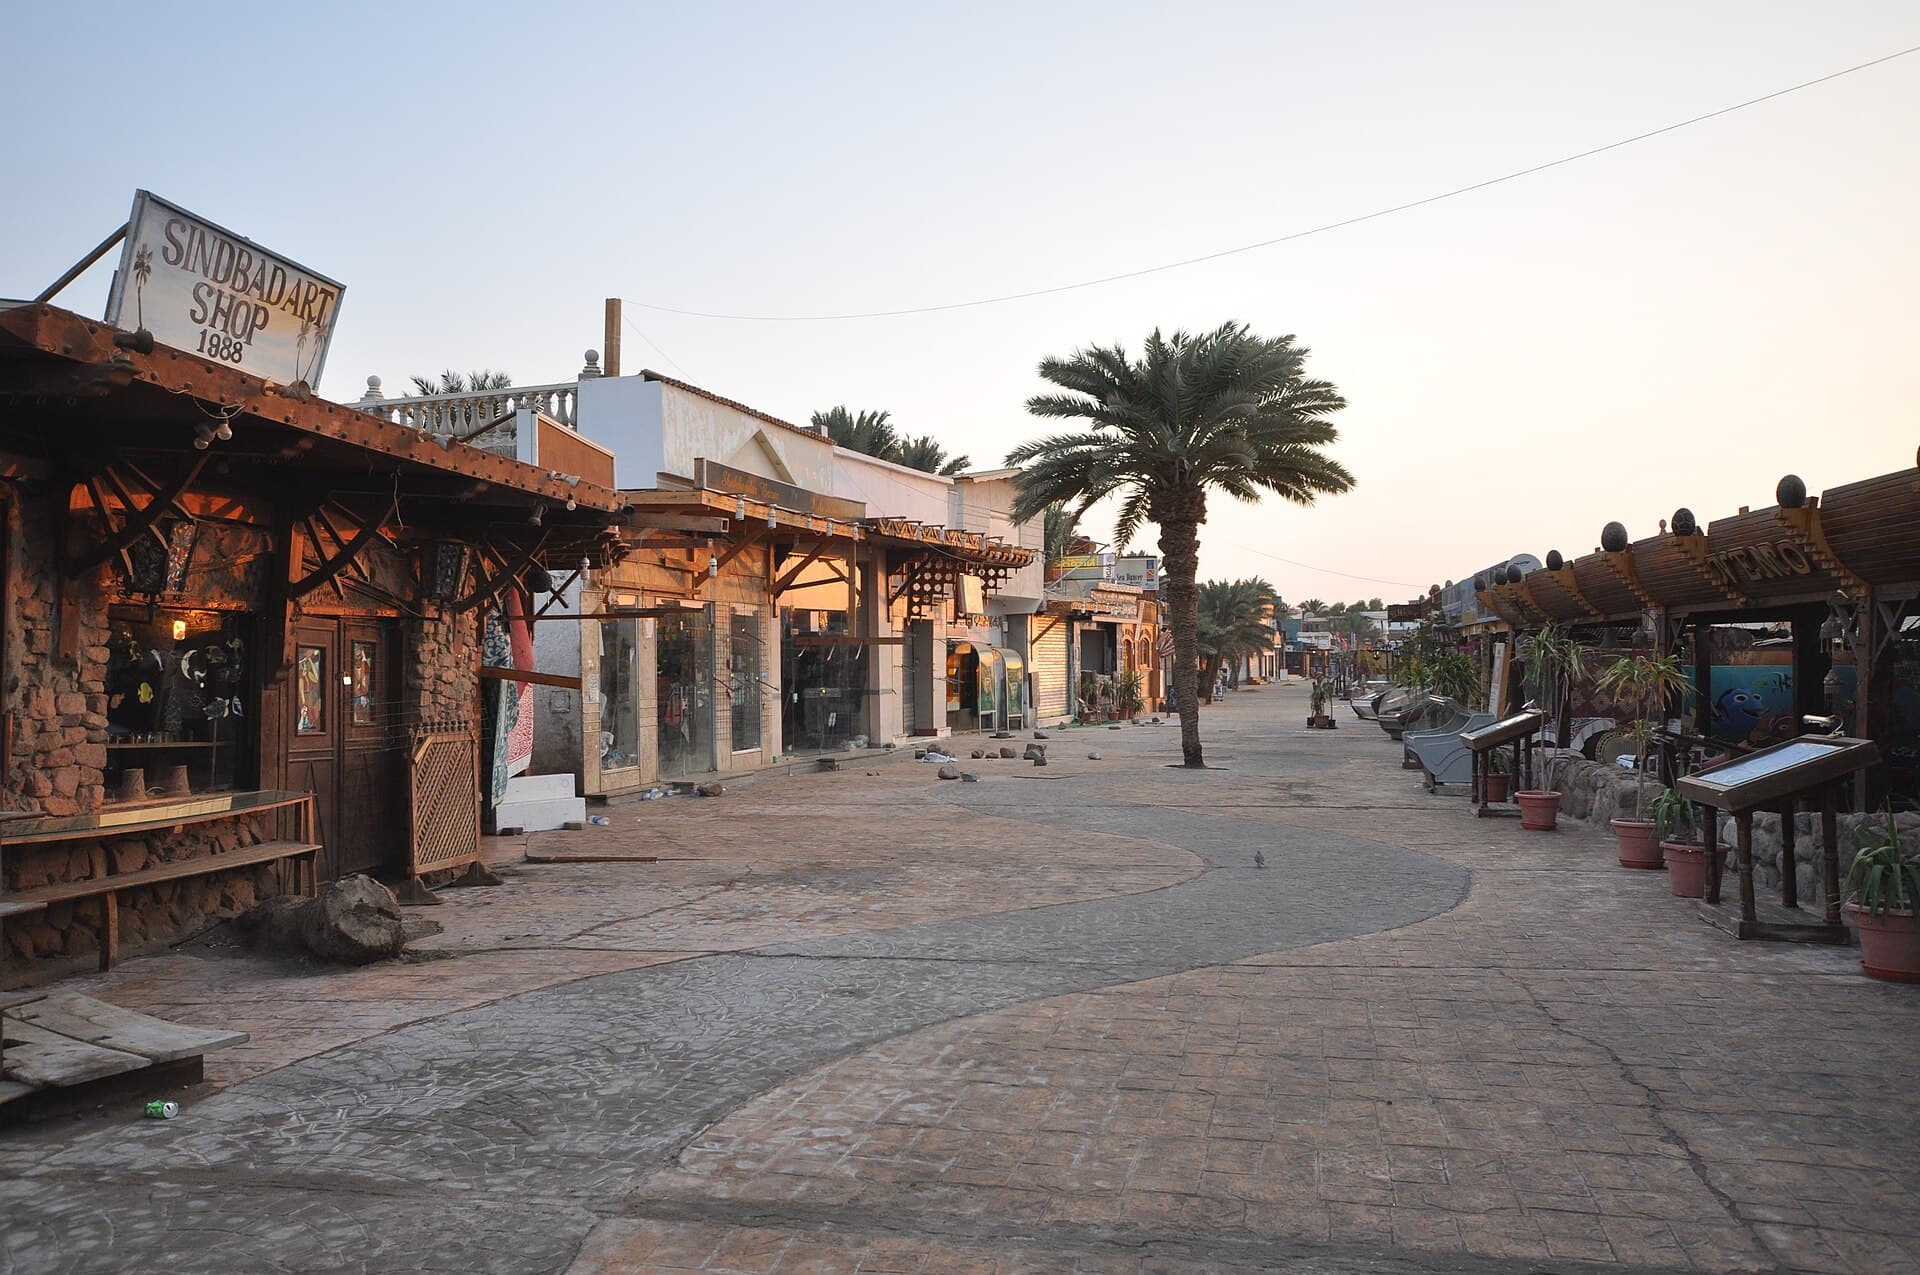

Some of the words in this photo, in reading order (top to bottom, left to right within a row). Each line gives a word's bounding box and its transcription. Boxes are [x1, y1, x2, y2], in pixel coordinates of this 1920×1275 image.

[162, 218, 287, 306] SINDBAD
[280, 277, 334, 328] ART
[190, 282, 270, 346] SHOP
[196, 329, 243, 364] 1988
[1704, 539, 1811, 583] NEMO
